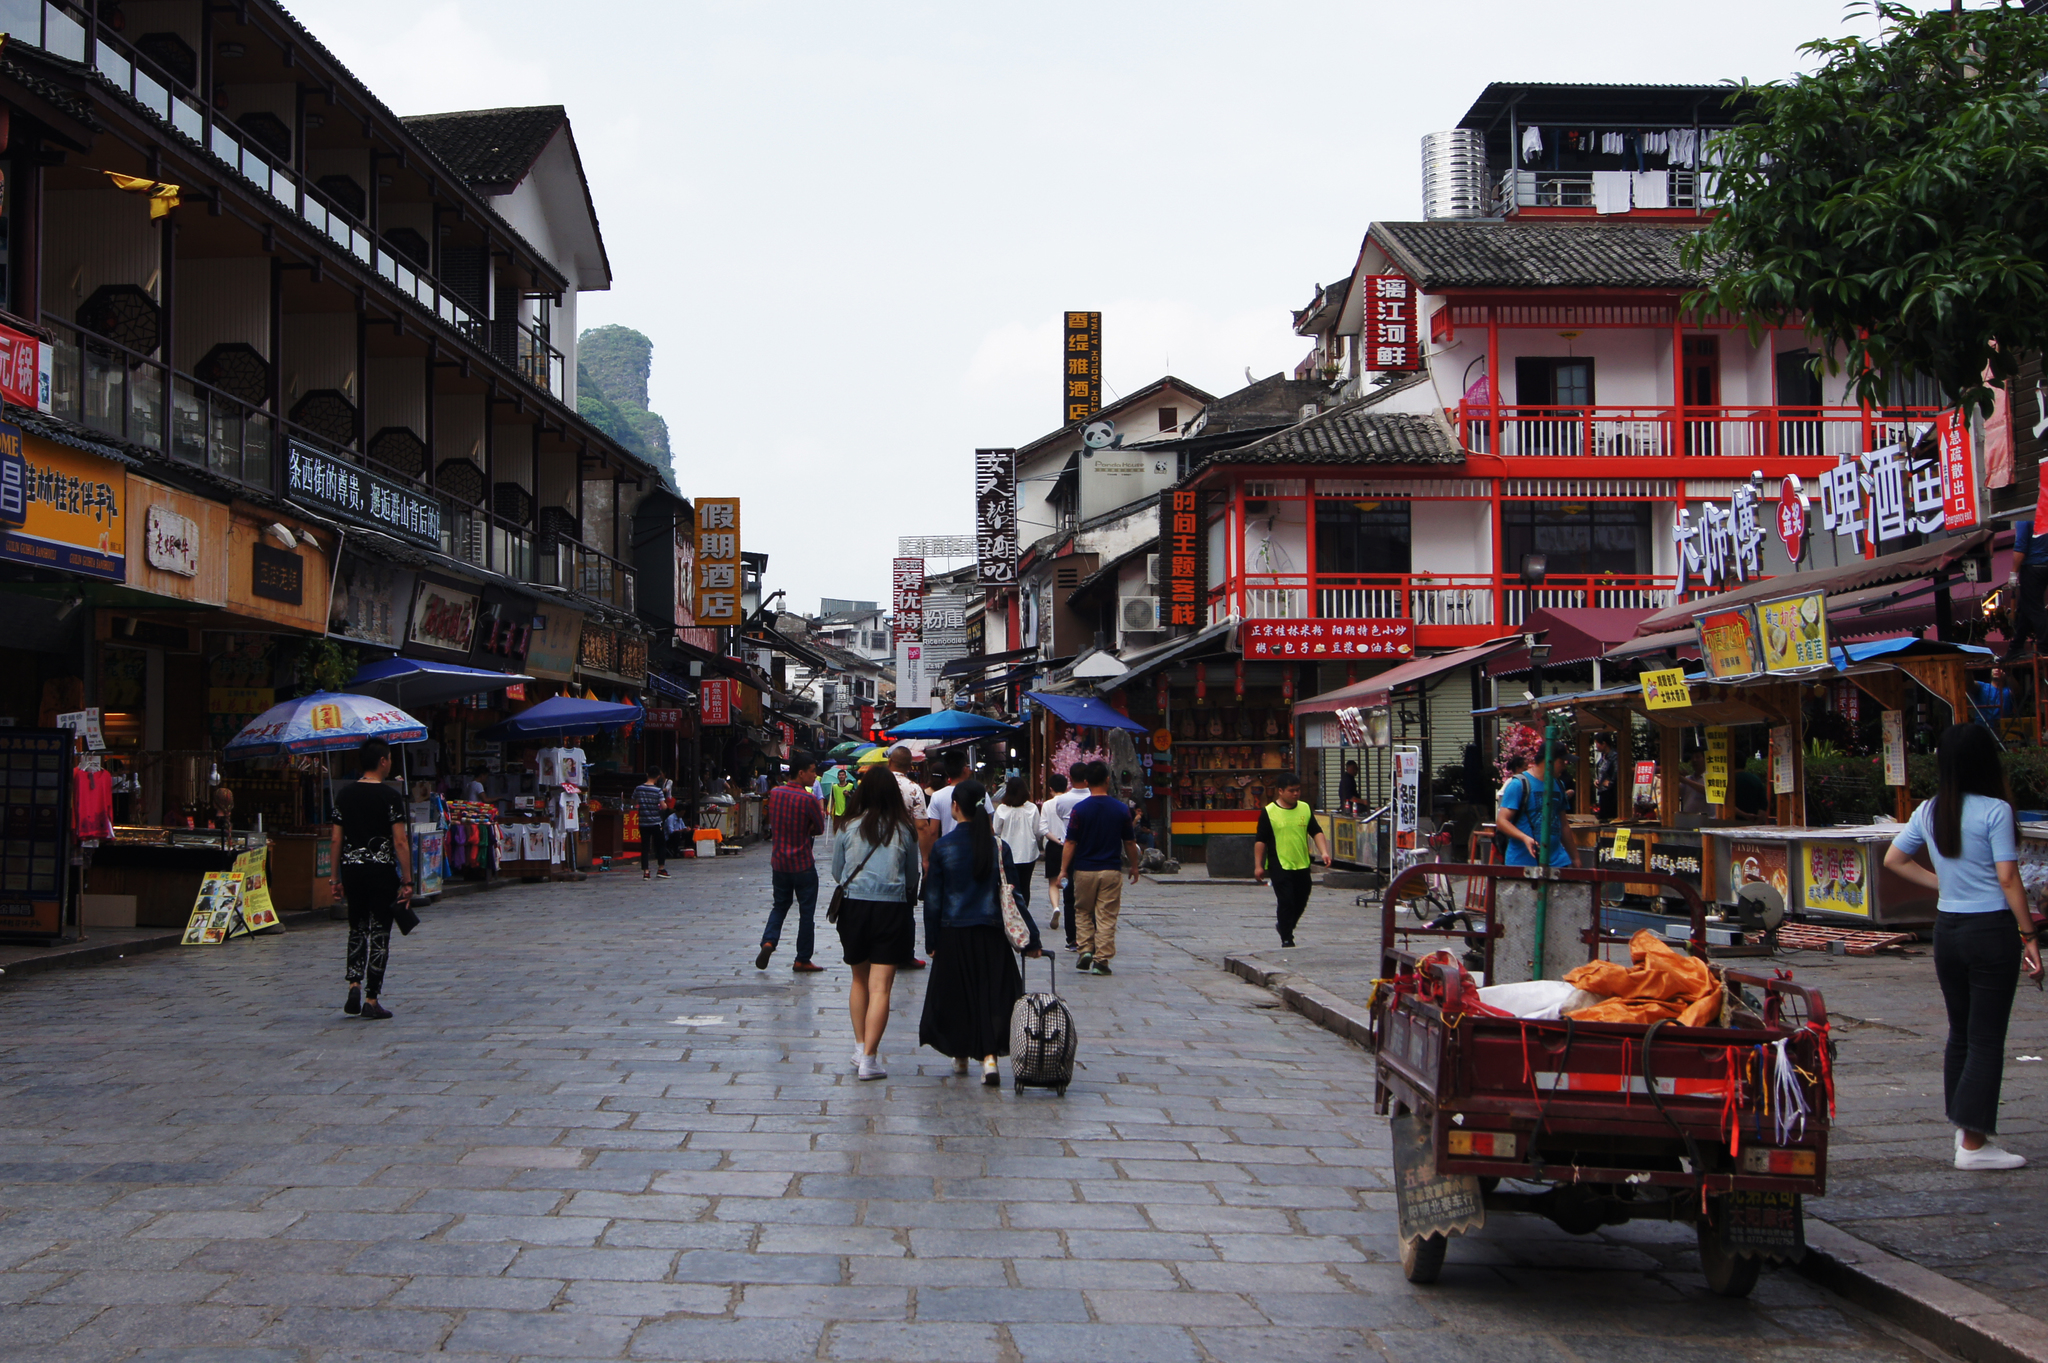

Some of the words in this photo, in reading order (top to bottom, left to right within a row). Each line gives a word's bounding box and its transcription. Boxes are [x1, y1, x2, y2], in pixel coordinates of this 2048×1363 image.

[1376, 278, 1406, 366] 漓江河鲜
[0, 433, 19, 458] ME
[1948, 413, 1966, 513] 应急疏散出口
[1945, 511, 1964, 527] Emergency
[699, 503, 735, 618] 假期酒店
[1171, 491, 1196, 625] 时间主题客栈
[1251, 624, 1325, 637] 正宗桂林米粉
[1332, 624, 1407, 637] 阳朔特色小炒
[1255, 643, 1267, 654] 粥
[1737, 843, 1760, 853] INDIA
